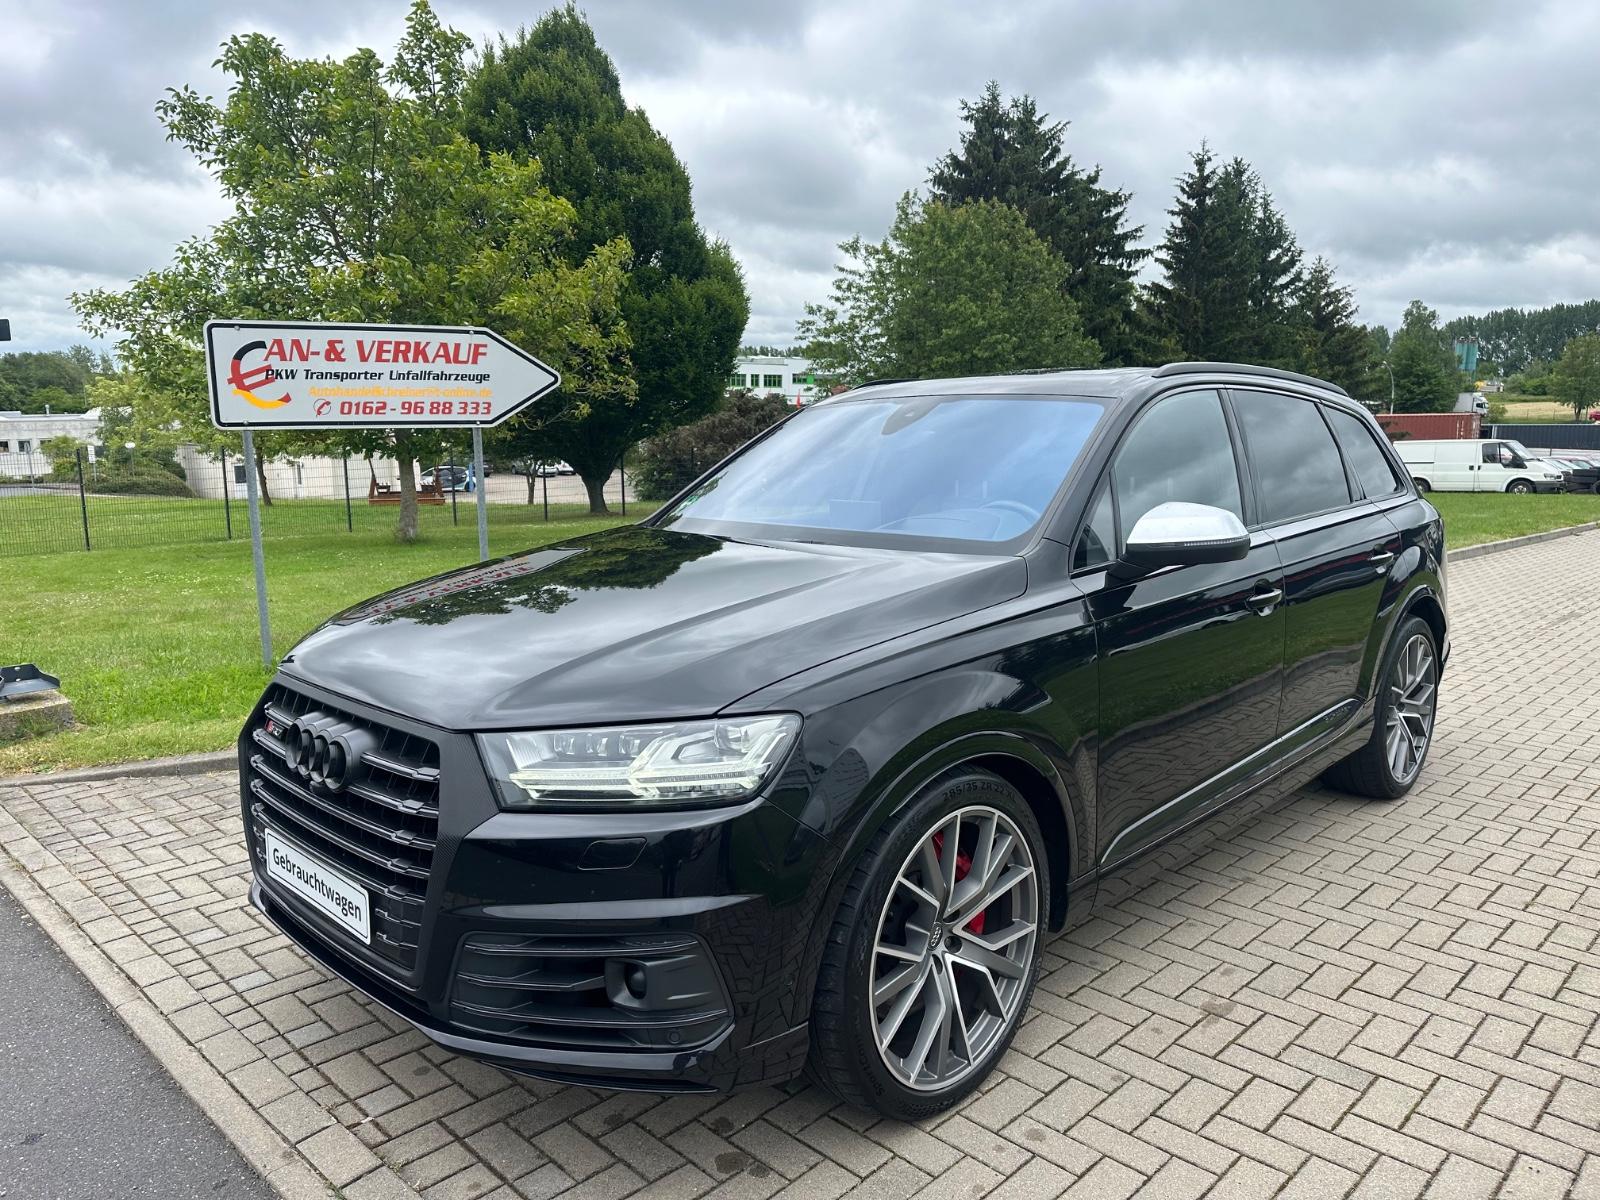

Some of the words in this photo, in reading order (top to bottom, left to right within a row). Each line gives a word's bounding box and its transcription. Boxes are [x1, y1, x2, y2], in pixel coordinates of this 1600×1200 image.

[263, 338, 320, 362] AN-
[324, 339, 347, 362] &
[356, 340, 488, 365] VERKAUF
[265, 369, 298, 381] PKW
[304, 369, 384, 382] Transporter
[389, 370, 490, 384] Unfallfahrzeuge
[340, 401, 387, 415] 0162
[400, 401, 425, 415] 96
[429, 401, 453, 415] 88
[457, 401, 492, 415] 333
[273, 848, 362, 922] Gebrauchtwagen
